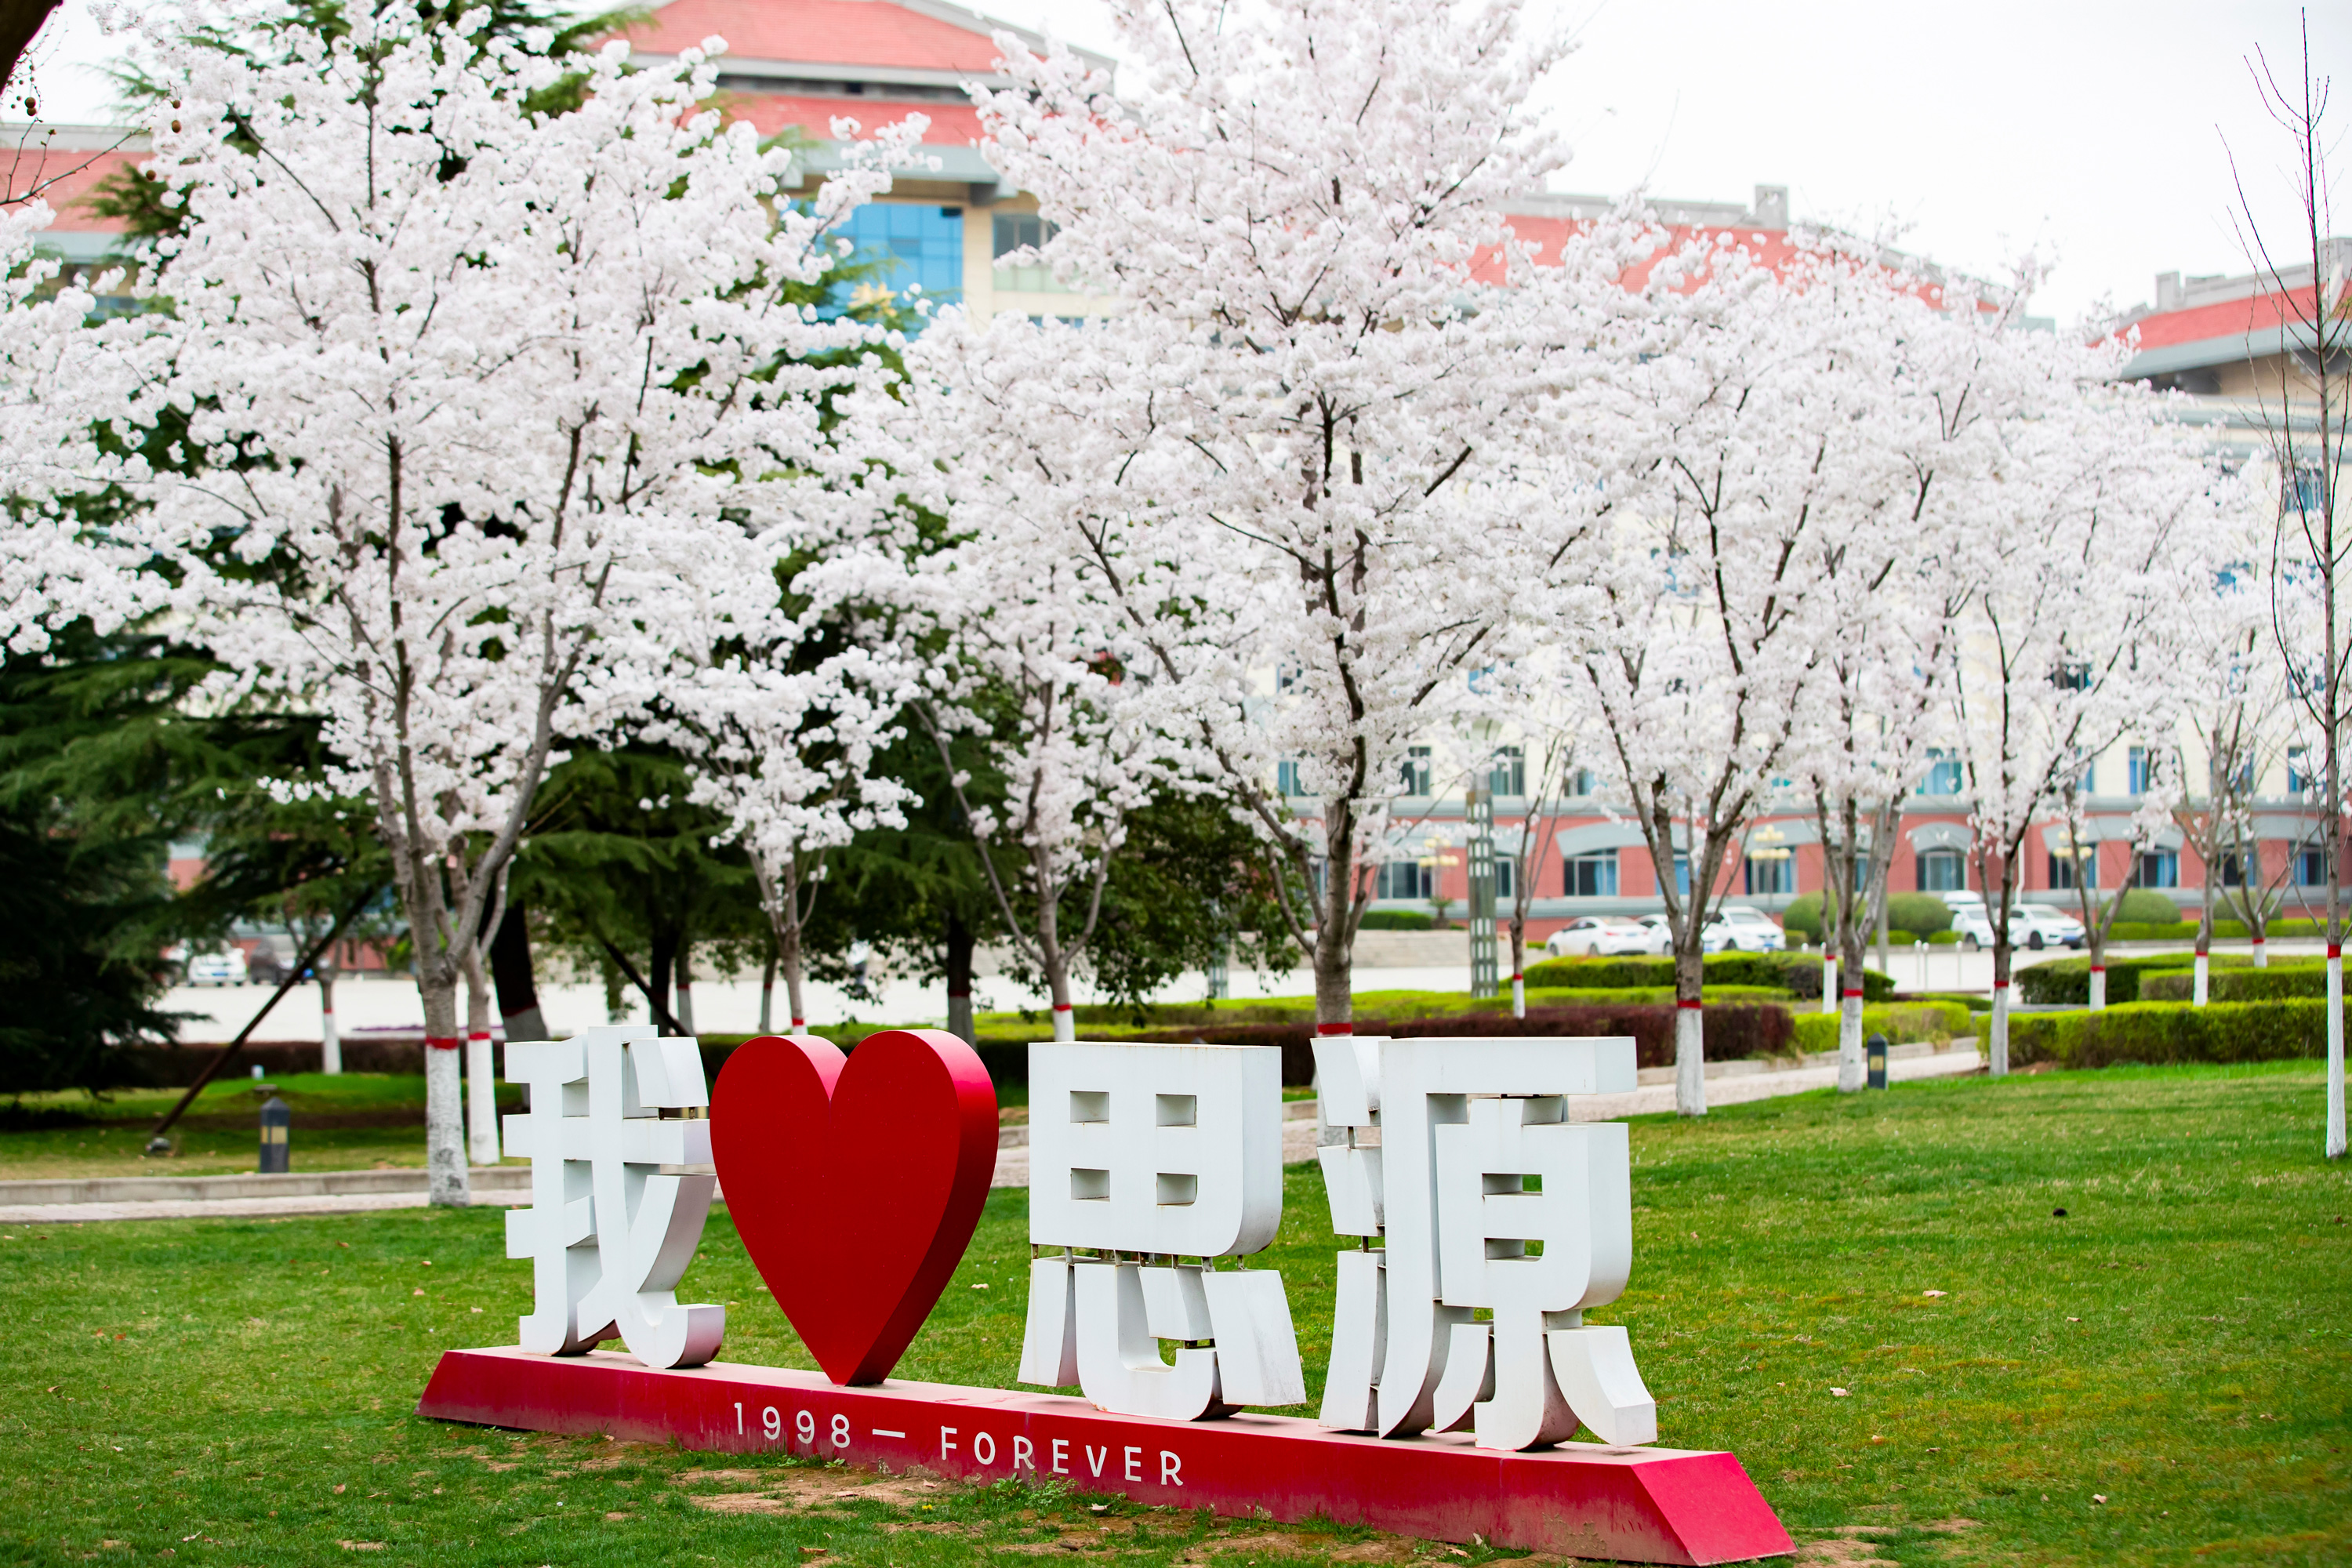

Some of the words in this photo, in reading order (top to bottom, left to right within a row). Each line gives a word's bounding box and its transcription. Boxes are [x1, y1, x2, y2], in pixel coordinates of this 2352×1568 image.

[503, 1025, 725, 1370] 我
[1018, 1035, 1657, 1451] 思源
[941, 1425, 1183, 1486] FOREVER
